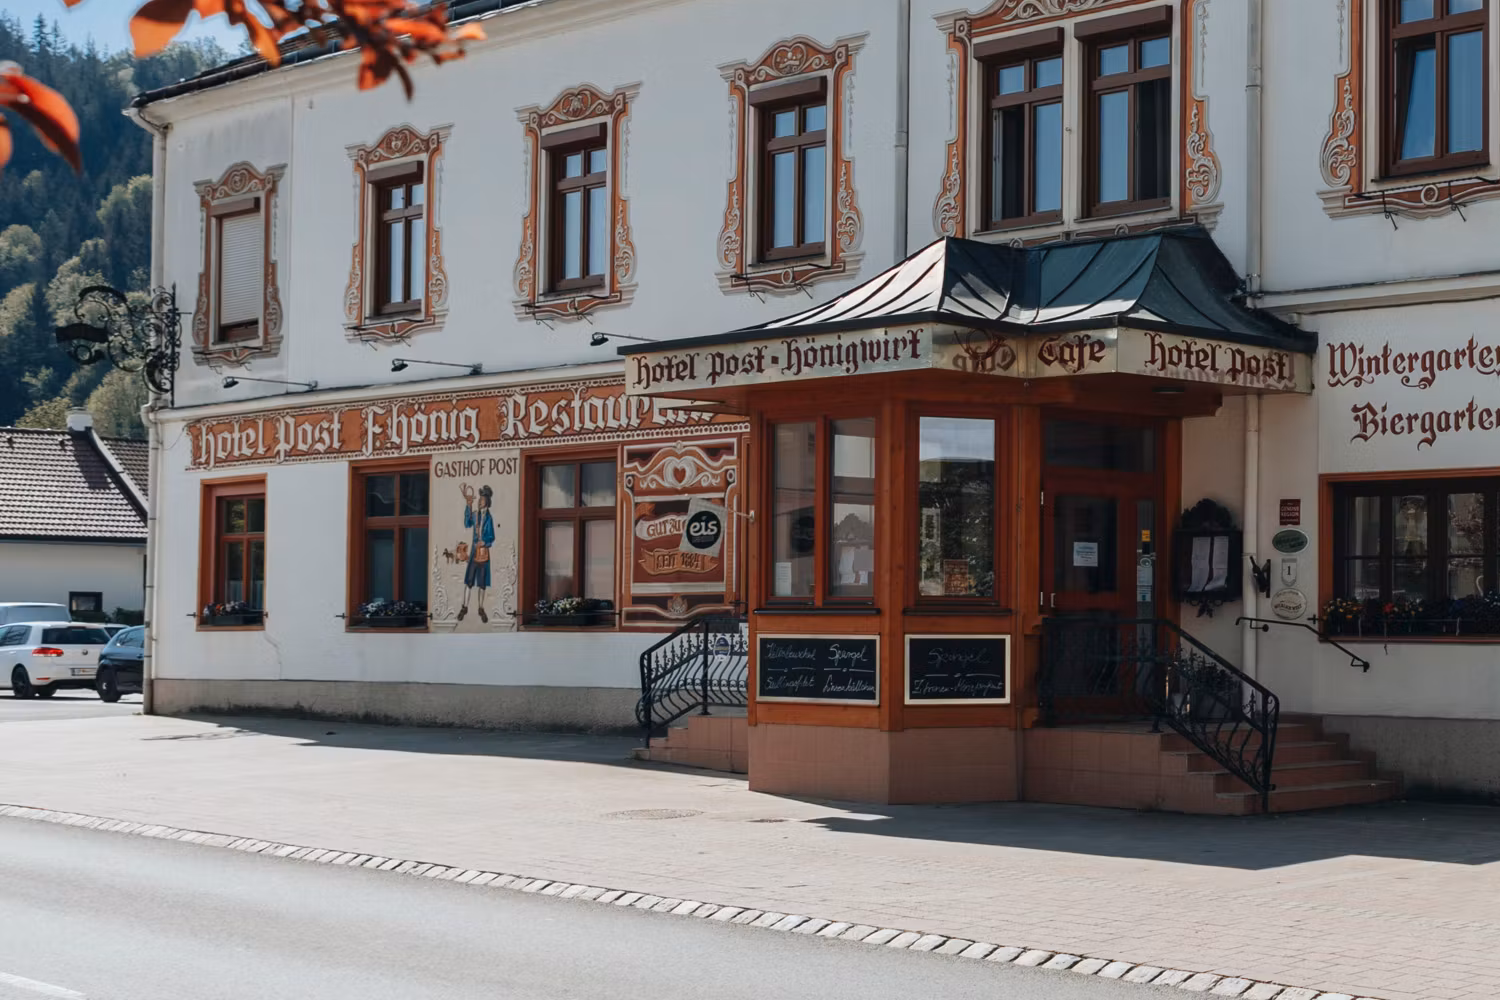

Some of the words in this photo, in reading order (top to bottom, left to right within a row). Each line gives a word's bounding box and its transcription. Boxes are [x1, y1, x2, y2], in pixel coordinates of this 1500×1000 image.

[497, 385, 714, 441] Restaura
[434, 458, 486, 478] GASTHOF
[489, 457, 519, 476] POST
[646, 519, 668, 537] GUT
[690, 516, 718, 536] eis
[656, 553, 677, 569] SEIT
[827, 643, 868, 667] Spargel
